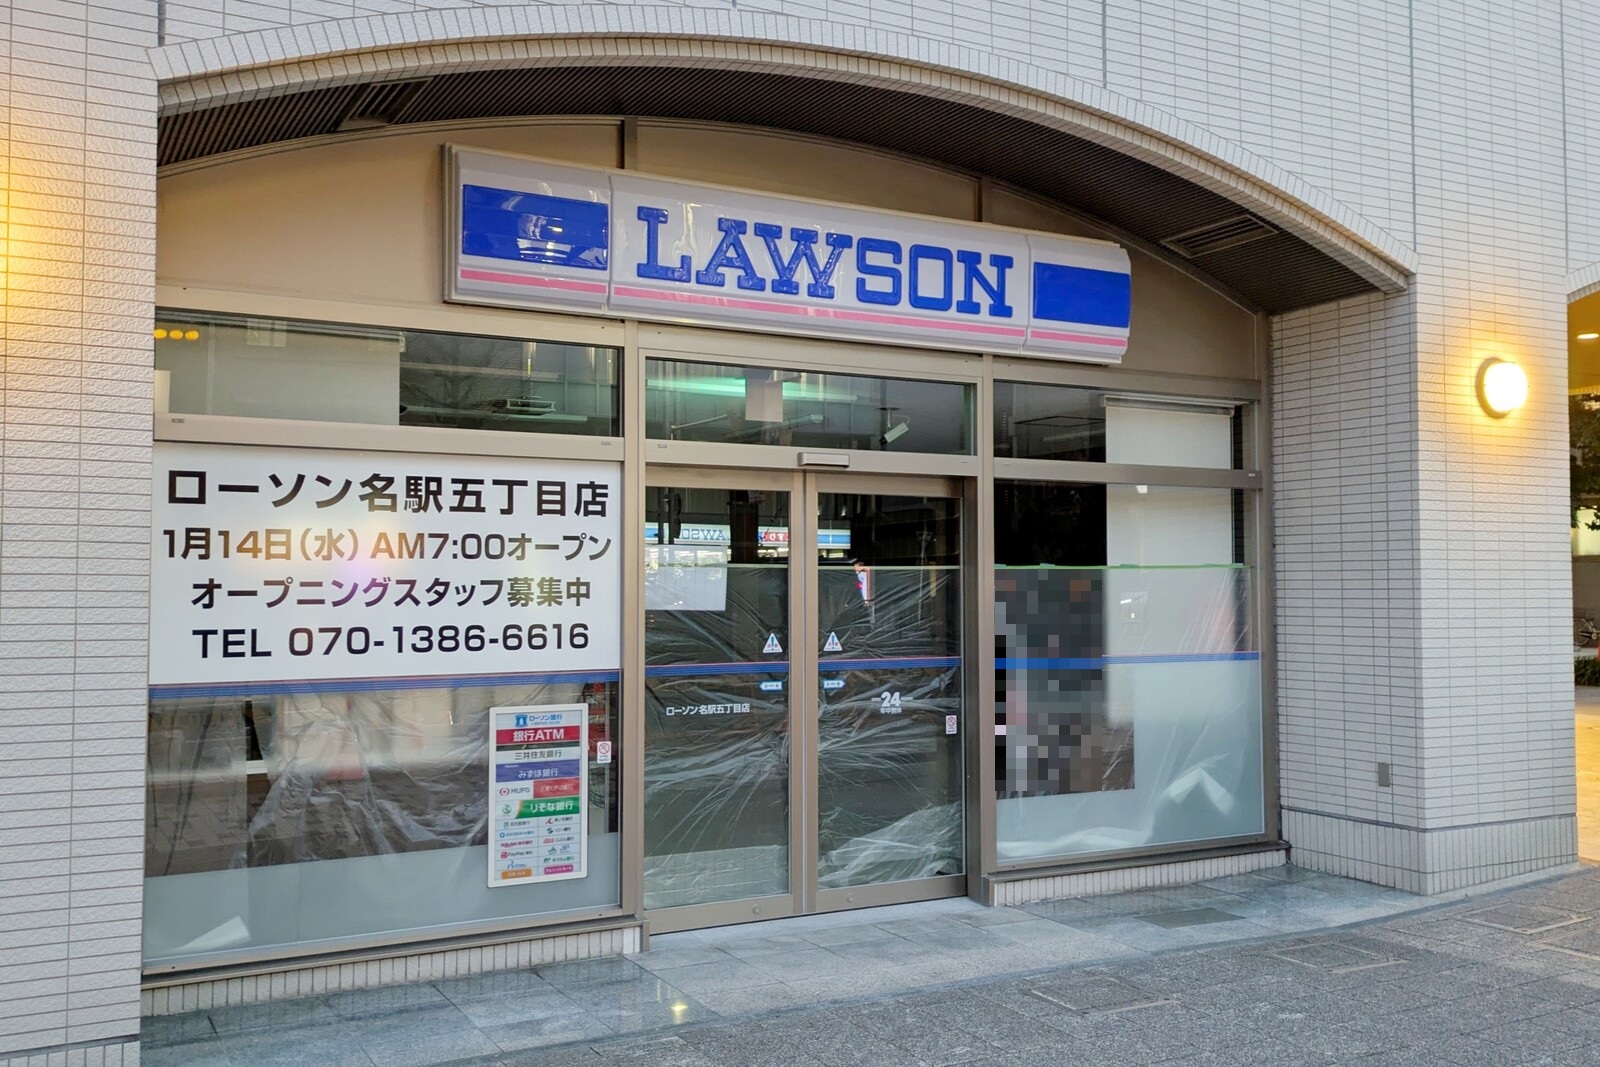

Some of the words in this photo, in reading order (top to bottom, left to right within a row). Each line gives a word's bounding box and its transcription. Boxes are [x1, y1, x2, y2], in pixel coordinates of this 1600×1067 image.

[637, 206, 1013, 318] LAWSON
[167, 470, 608, 517] ローソン名駅五丁目店
[163, 528, 358, 561] 1月14日(水)
[370, 532, 612, 561] AM7:00オープン
[191, 576, 591, 609] オープニングスタッフ募集中
[192, 628, 272, 658] TEL
[289, 623, 589, 656] 070-1386-6616
[880, 692, 901, 707] 24
[666, 703, 750, 716] ローソン名駅五丁目店
[513, 729, 564, 742] 銀行ATM
[515, 750, 562, 760] 三井住友銀行
[518, 768, 558, 778] みずほ銀行
[530, 801, 573, 813] りそな銀行
